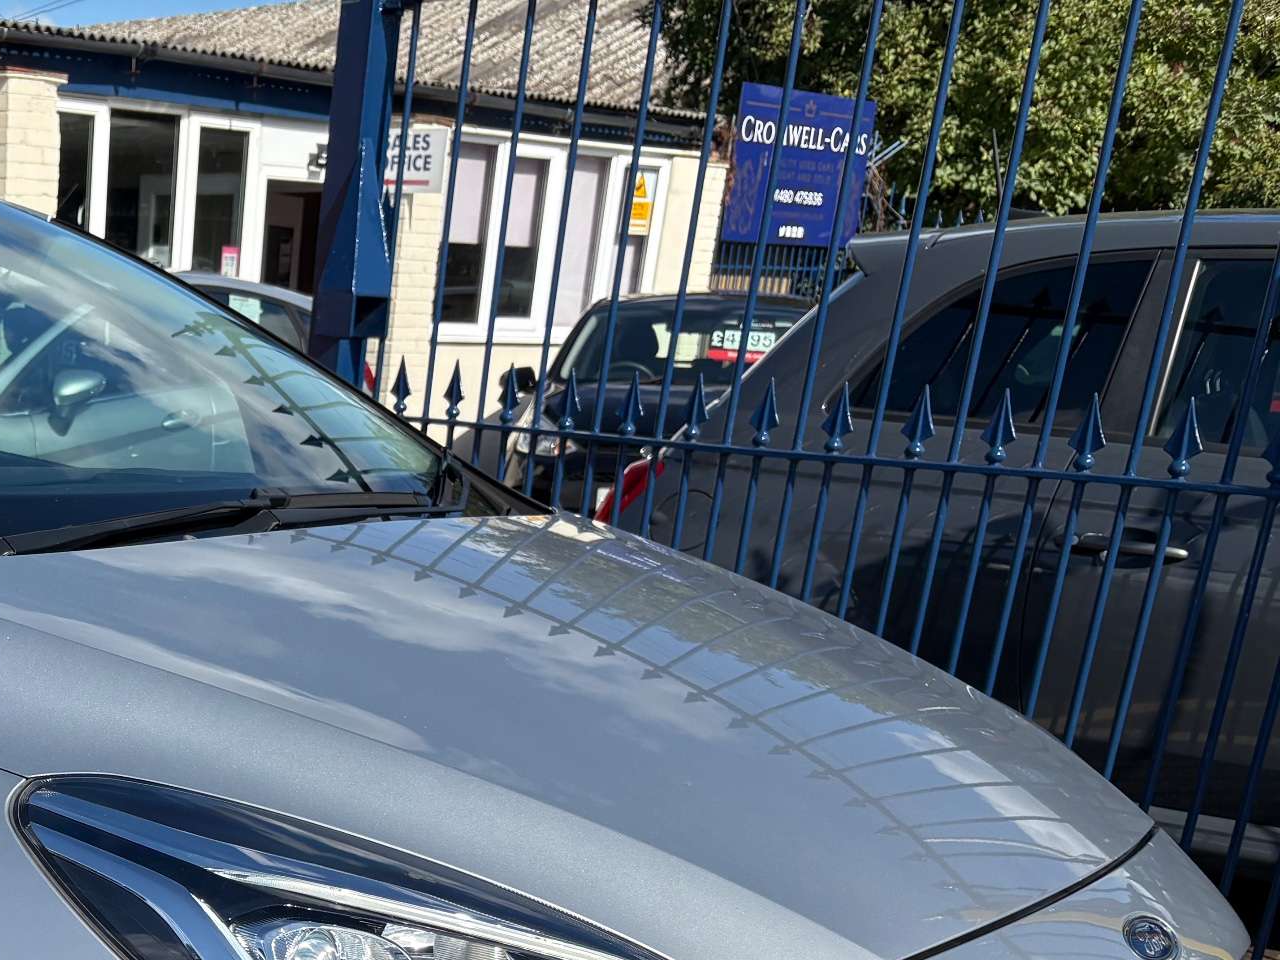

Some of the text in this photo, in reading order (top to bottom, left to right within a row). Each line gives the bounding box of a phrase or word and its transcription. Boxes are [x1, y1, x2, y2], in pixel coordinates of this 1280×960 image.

[384, 134, 431, 151] ALES
[383, 154, 432, 172] FICE
[711, 330, 774, 349] £495
